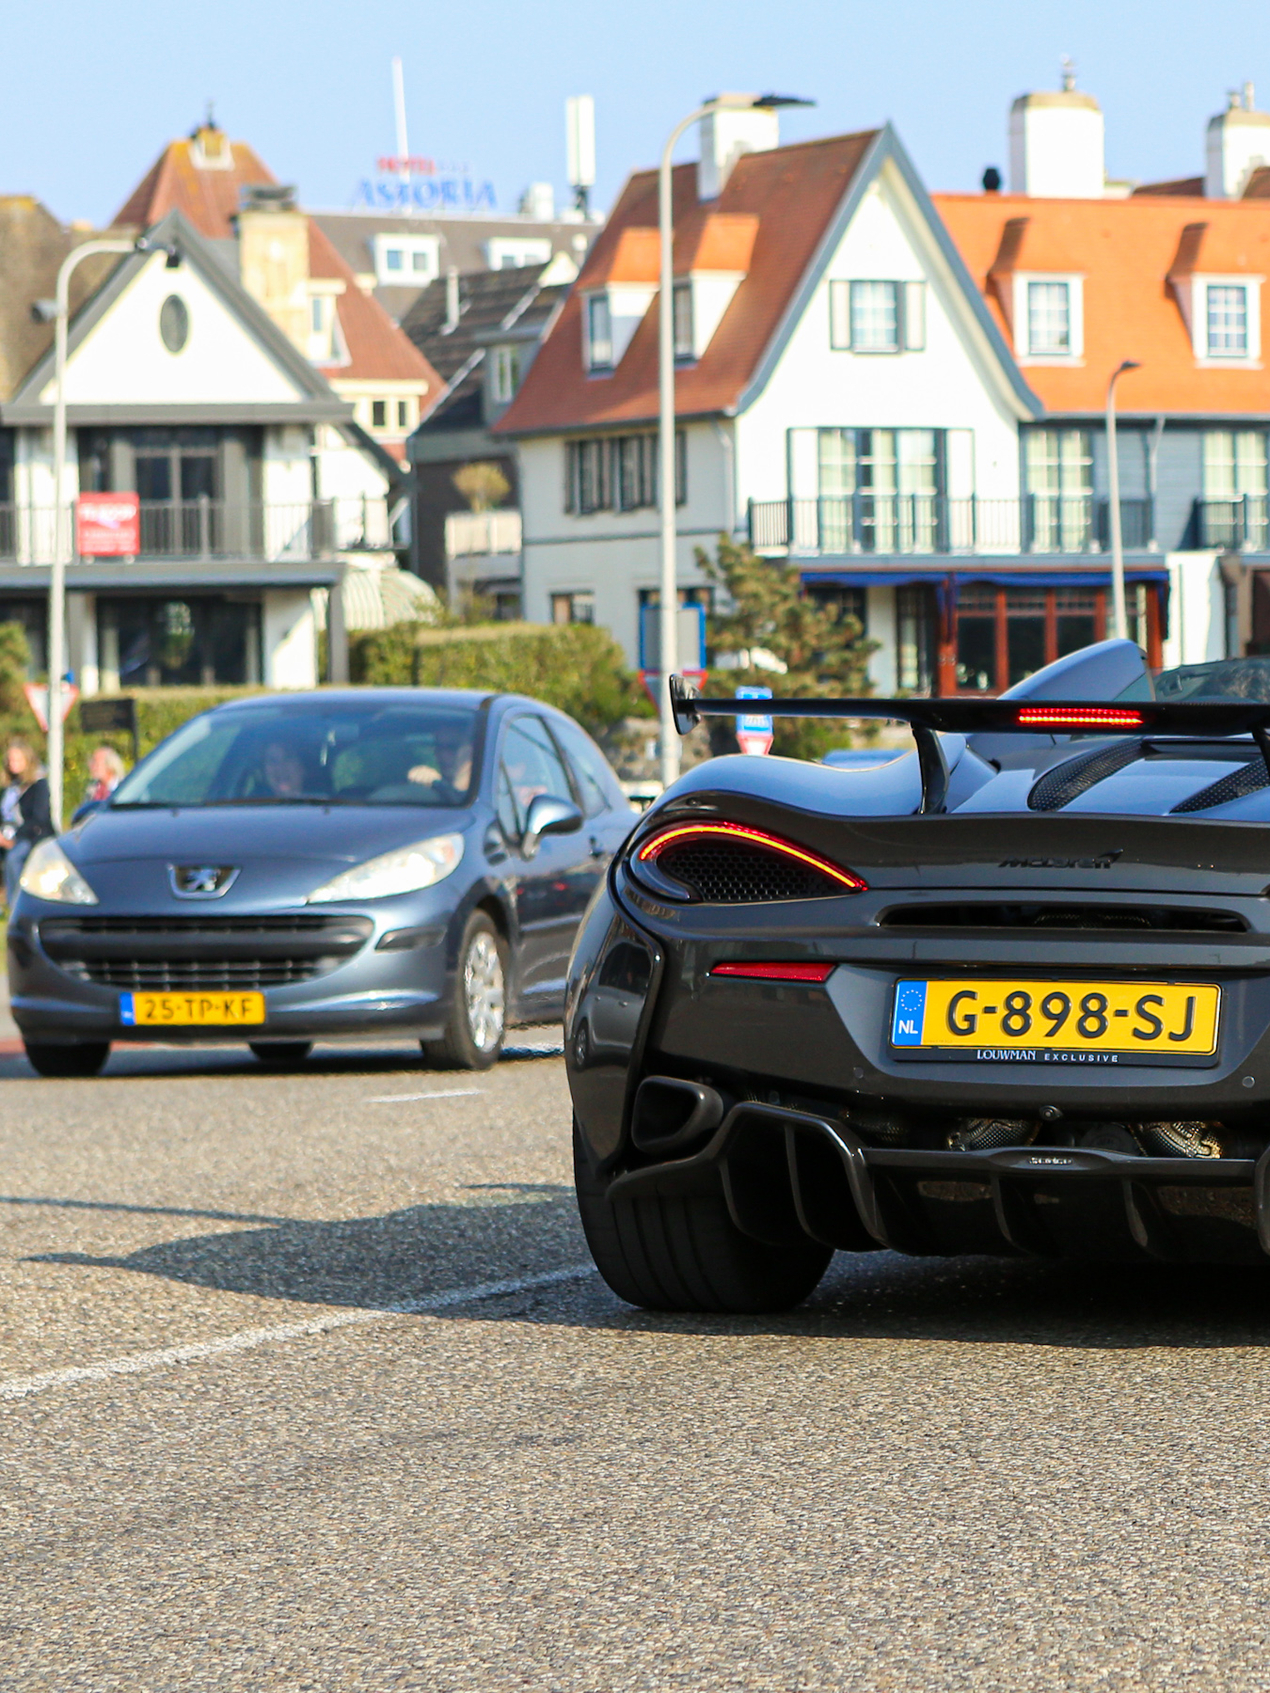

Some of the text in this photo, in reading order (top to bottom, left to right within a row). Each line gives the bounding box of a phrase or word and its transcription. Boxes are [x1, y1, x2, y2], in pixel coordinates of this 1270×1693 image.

[350, 178, 499, 209] ASTORIA
[144, 998, 253, 1020] 25-TP-KF
[945, 989, 1197, 1042] G-898-SJ
[898, 1019, 918, 1035] NL
[976, 1049, 1119, 1064] LOUWMAN EXCLUSIVE
